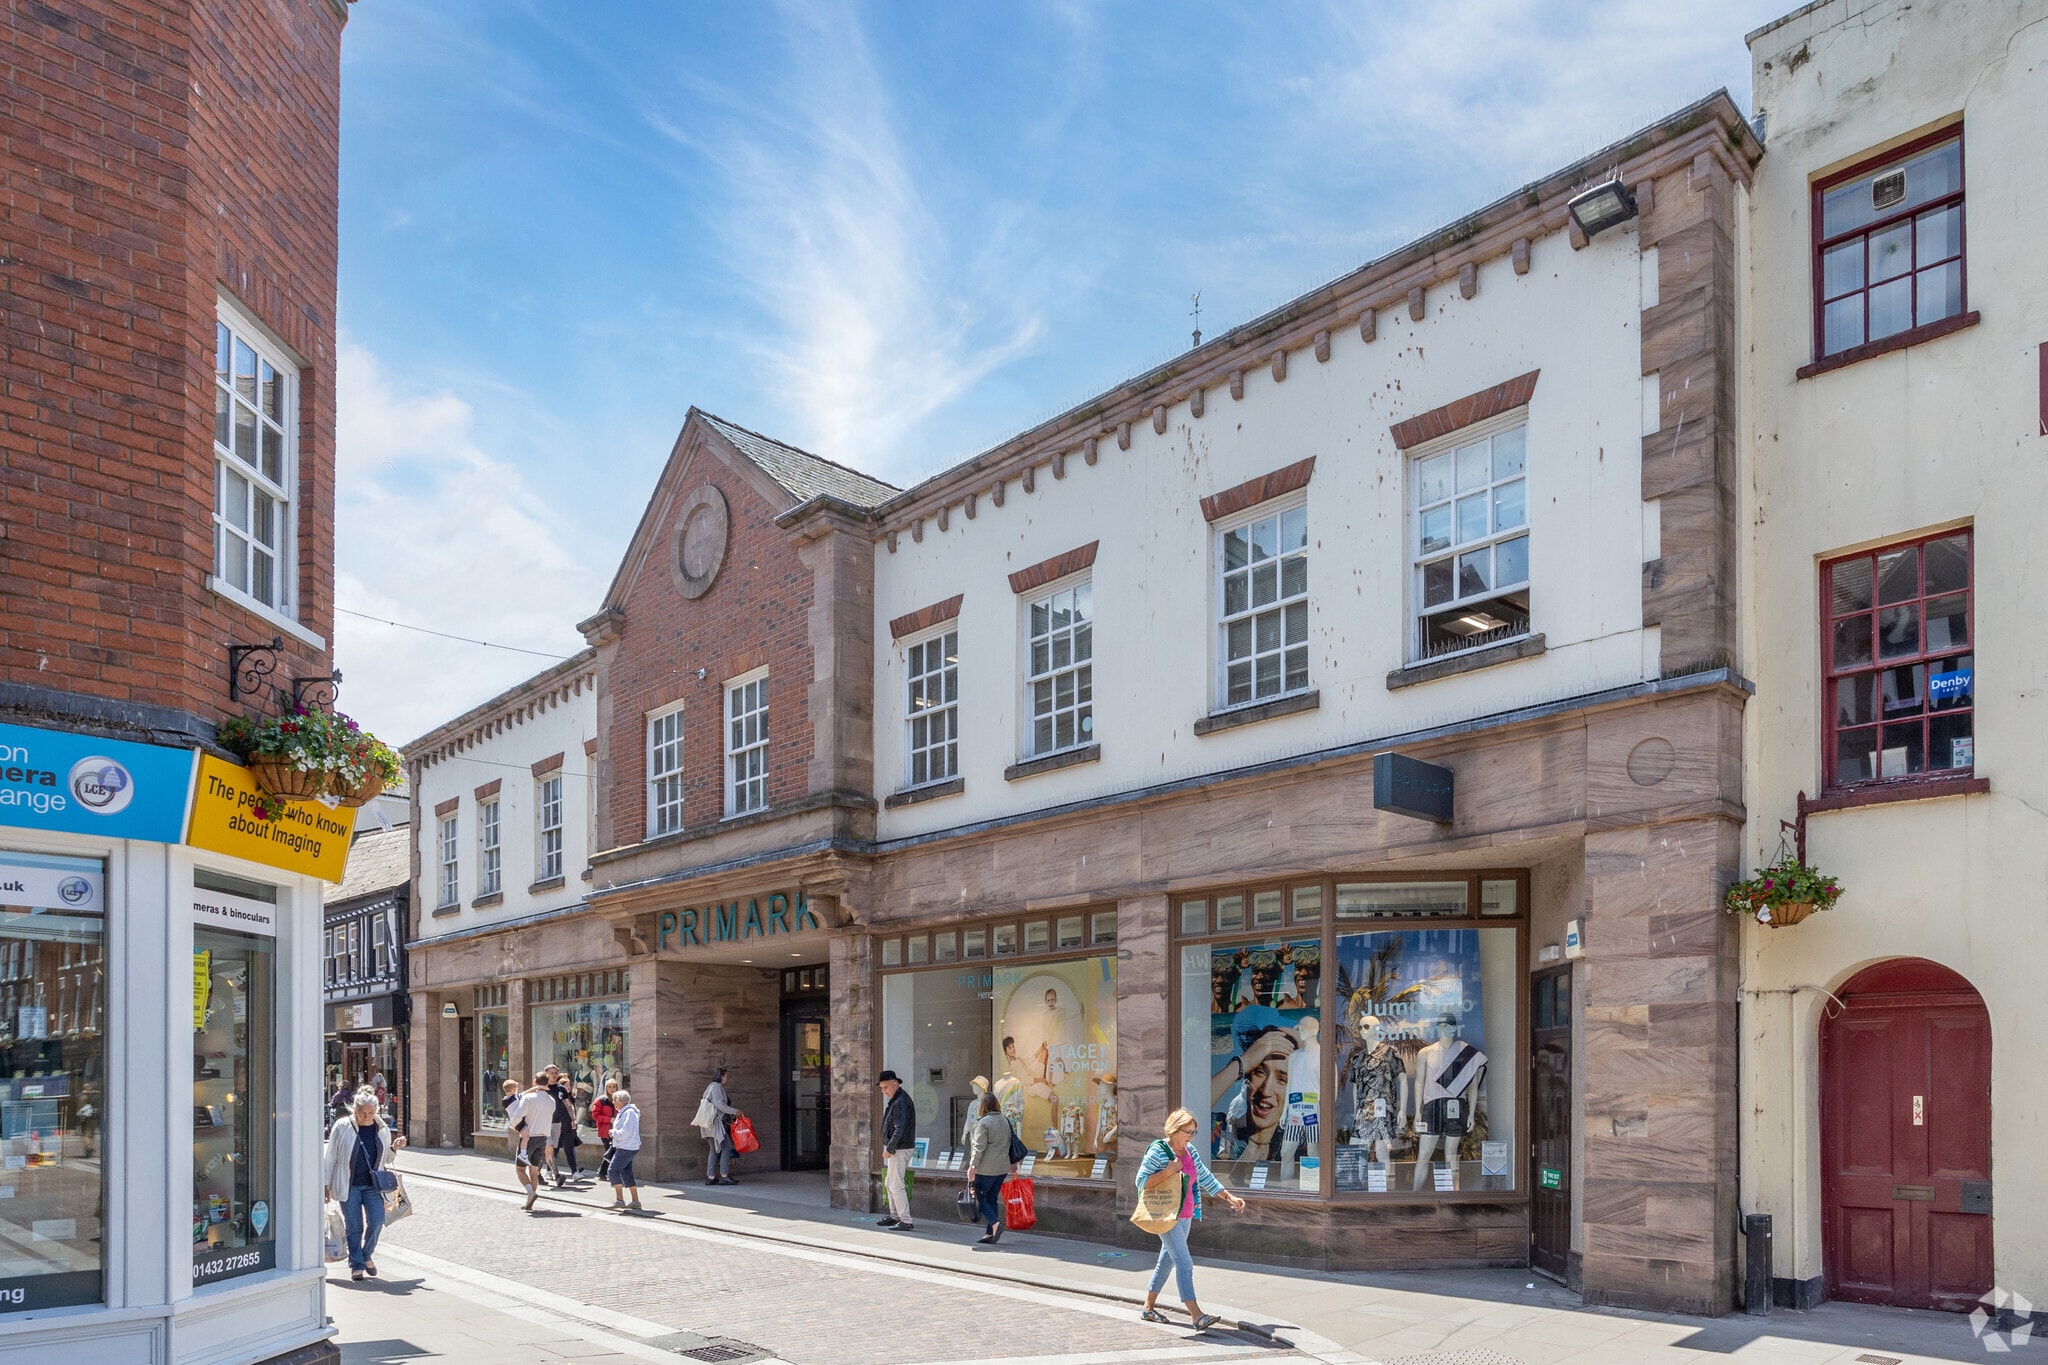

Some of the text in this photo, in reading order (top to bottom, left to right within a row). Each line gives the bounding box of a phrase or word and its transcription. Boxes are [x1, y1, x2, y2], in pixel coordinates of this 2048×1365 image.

[1931, 675, 1971, 690] Denby
[0, 767, 56, 787] era
[84, 783, 106, 795] LCE
[208, 775, 234, 801] The
[288, 806, 313, 826] who
[315, 813, 348, 837] know
[228, 813, 322, 858] about Imaging
[221, 906, 228, 916] &
[230, 907, 270, 924] binoculars
[659, 891, 816, 950] PRIMARK
[957, 971, 1022, 989] PRIMARK
[1361, 998, 1421, 1019] Jump
[1372, 1023, 1465, 1041] Summer
[1049, 1043, 1107, 1060] STACEY
[1049, 1060, 1109, 1073] SOLOMON
[193, 1251, 260, 1278] 01432 272655
